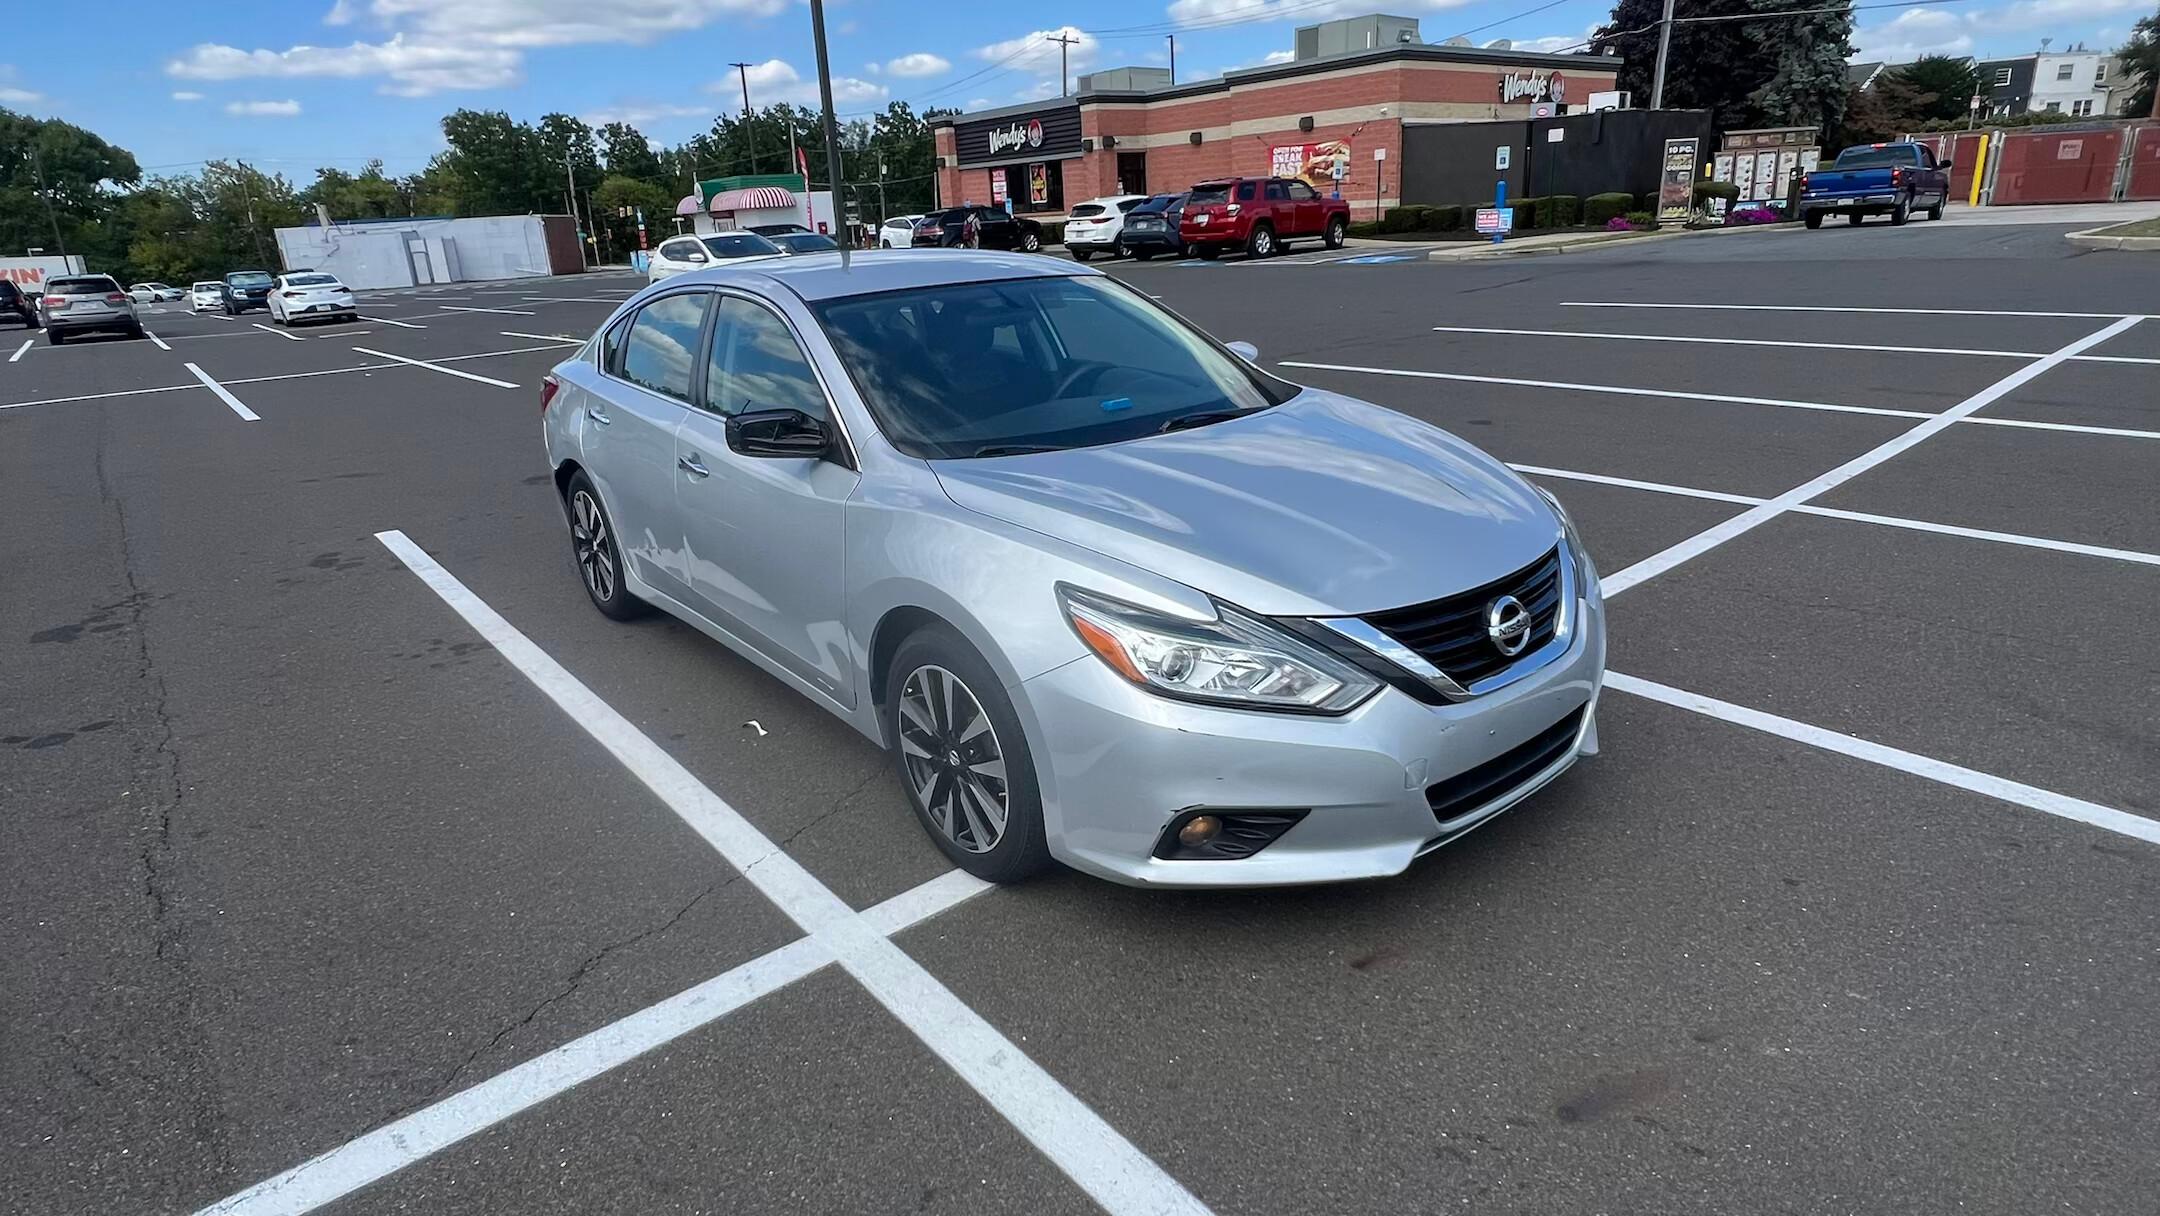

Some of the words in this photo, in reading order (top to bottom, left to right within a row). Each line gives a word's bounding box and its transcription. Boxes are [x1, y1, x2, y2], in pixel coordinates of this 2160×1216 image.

[1504, 69, 1547, 103] Wendy's
[989, 122, 1026, 154] Wendy's
[1273, 152, 1303, 164] BREAK
[1273, 162, 1304, 176] FAST
